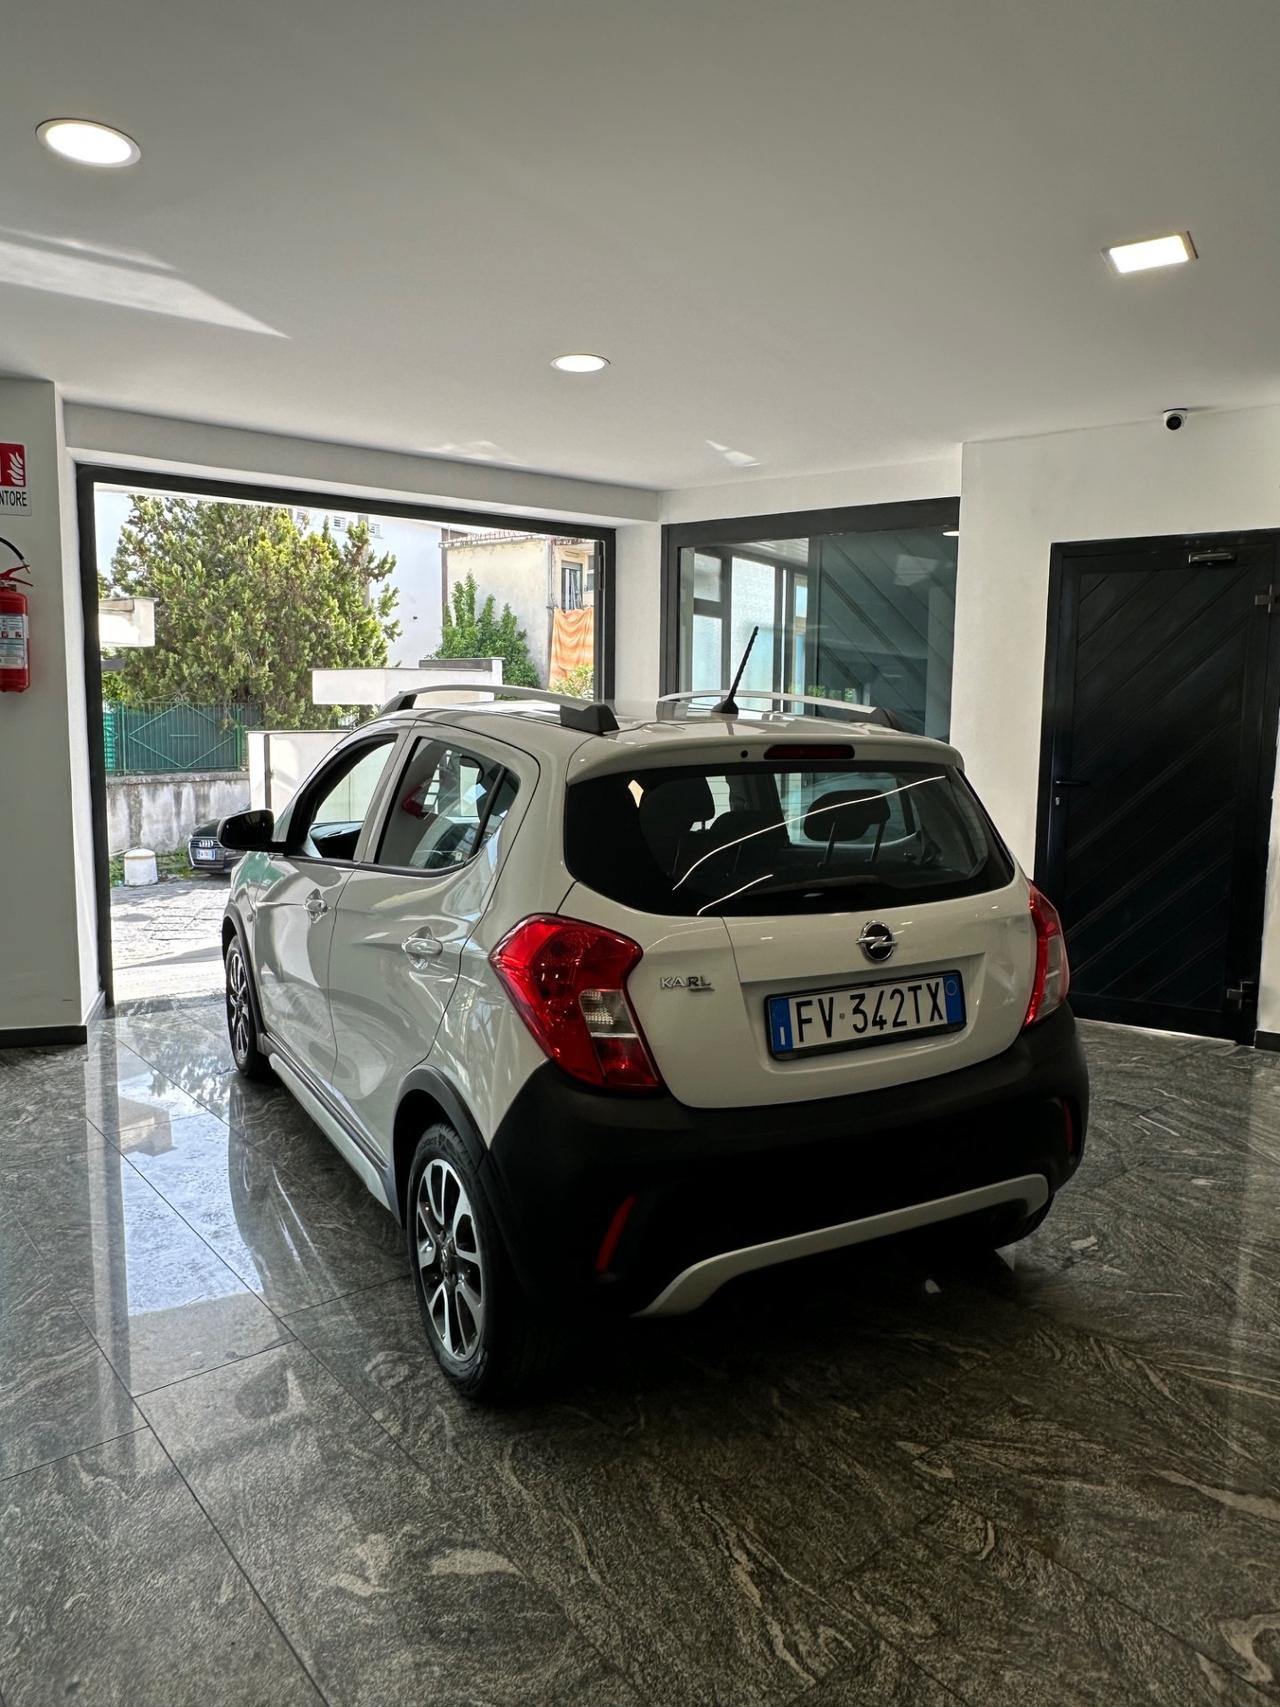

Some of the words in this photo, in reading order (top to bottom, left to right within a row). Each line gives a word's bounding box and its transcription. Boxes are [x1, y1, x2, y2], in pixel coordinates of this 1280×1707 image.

[660, 975, 712, 989] KARL
[795, 997, 834, 1043] FV
[849, 981, 944, 1034] 342TX
